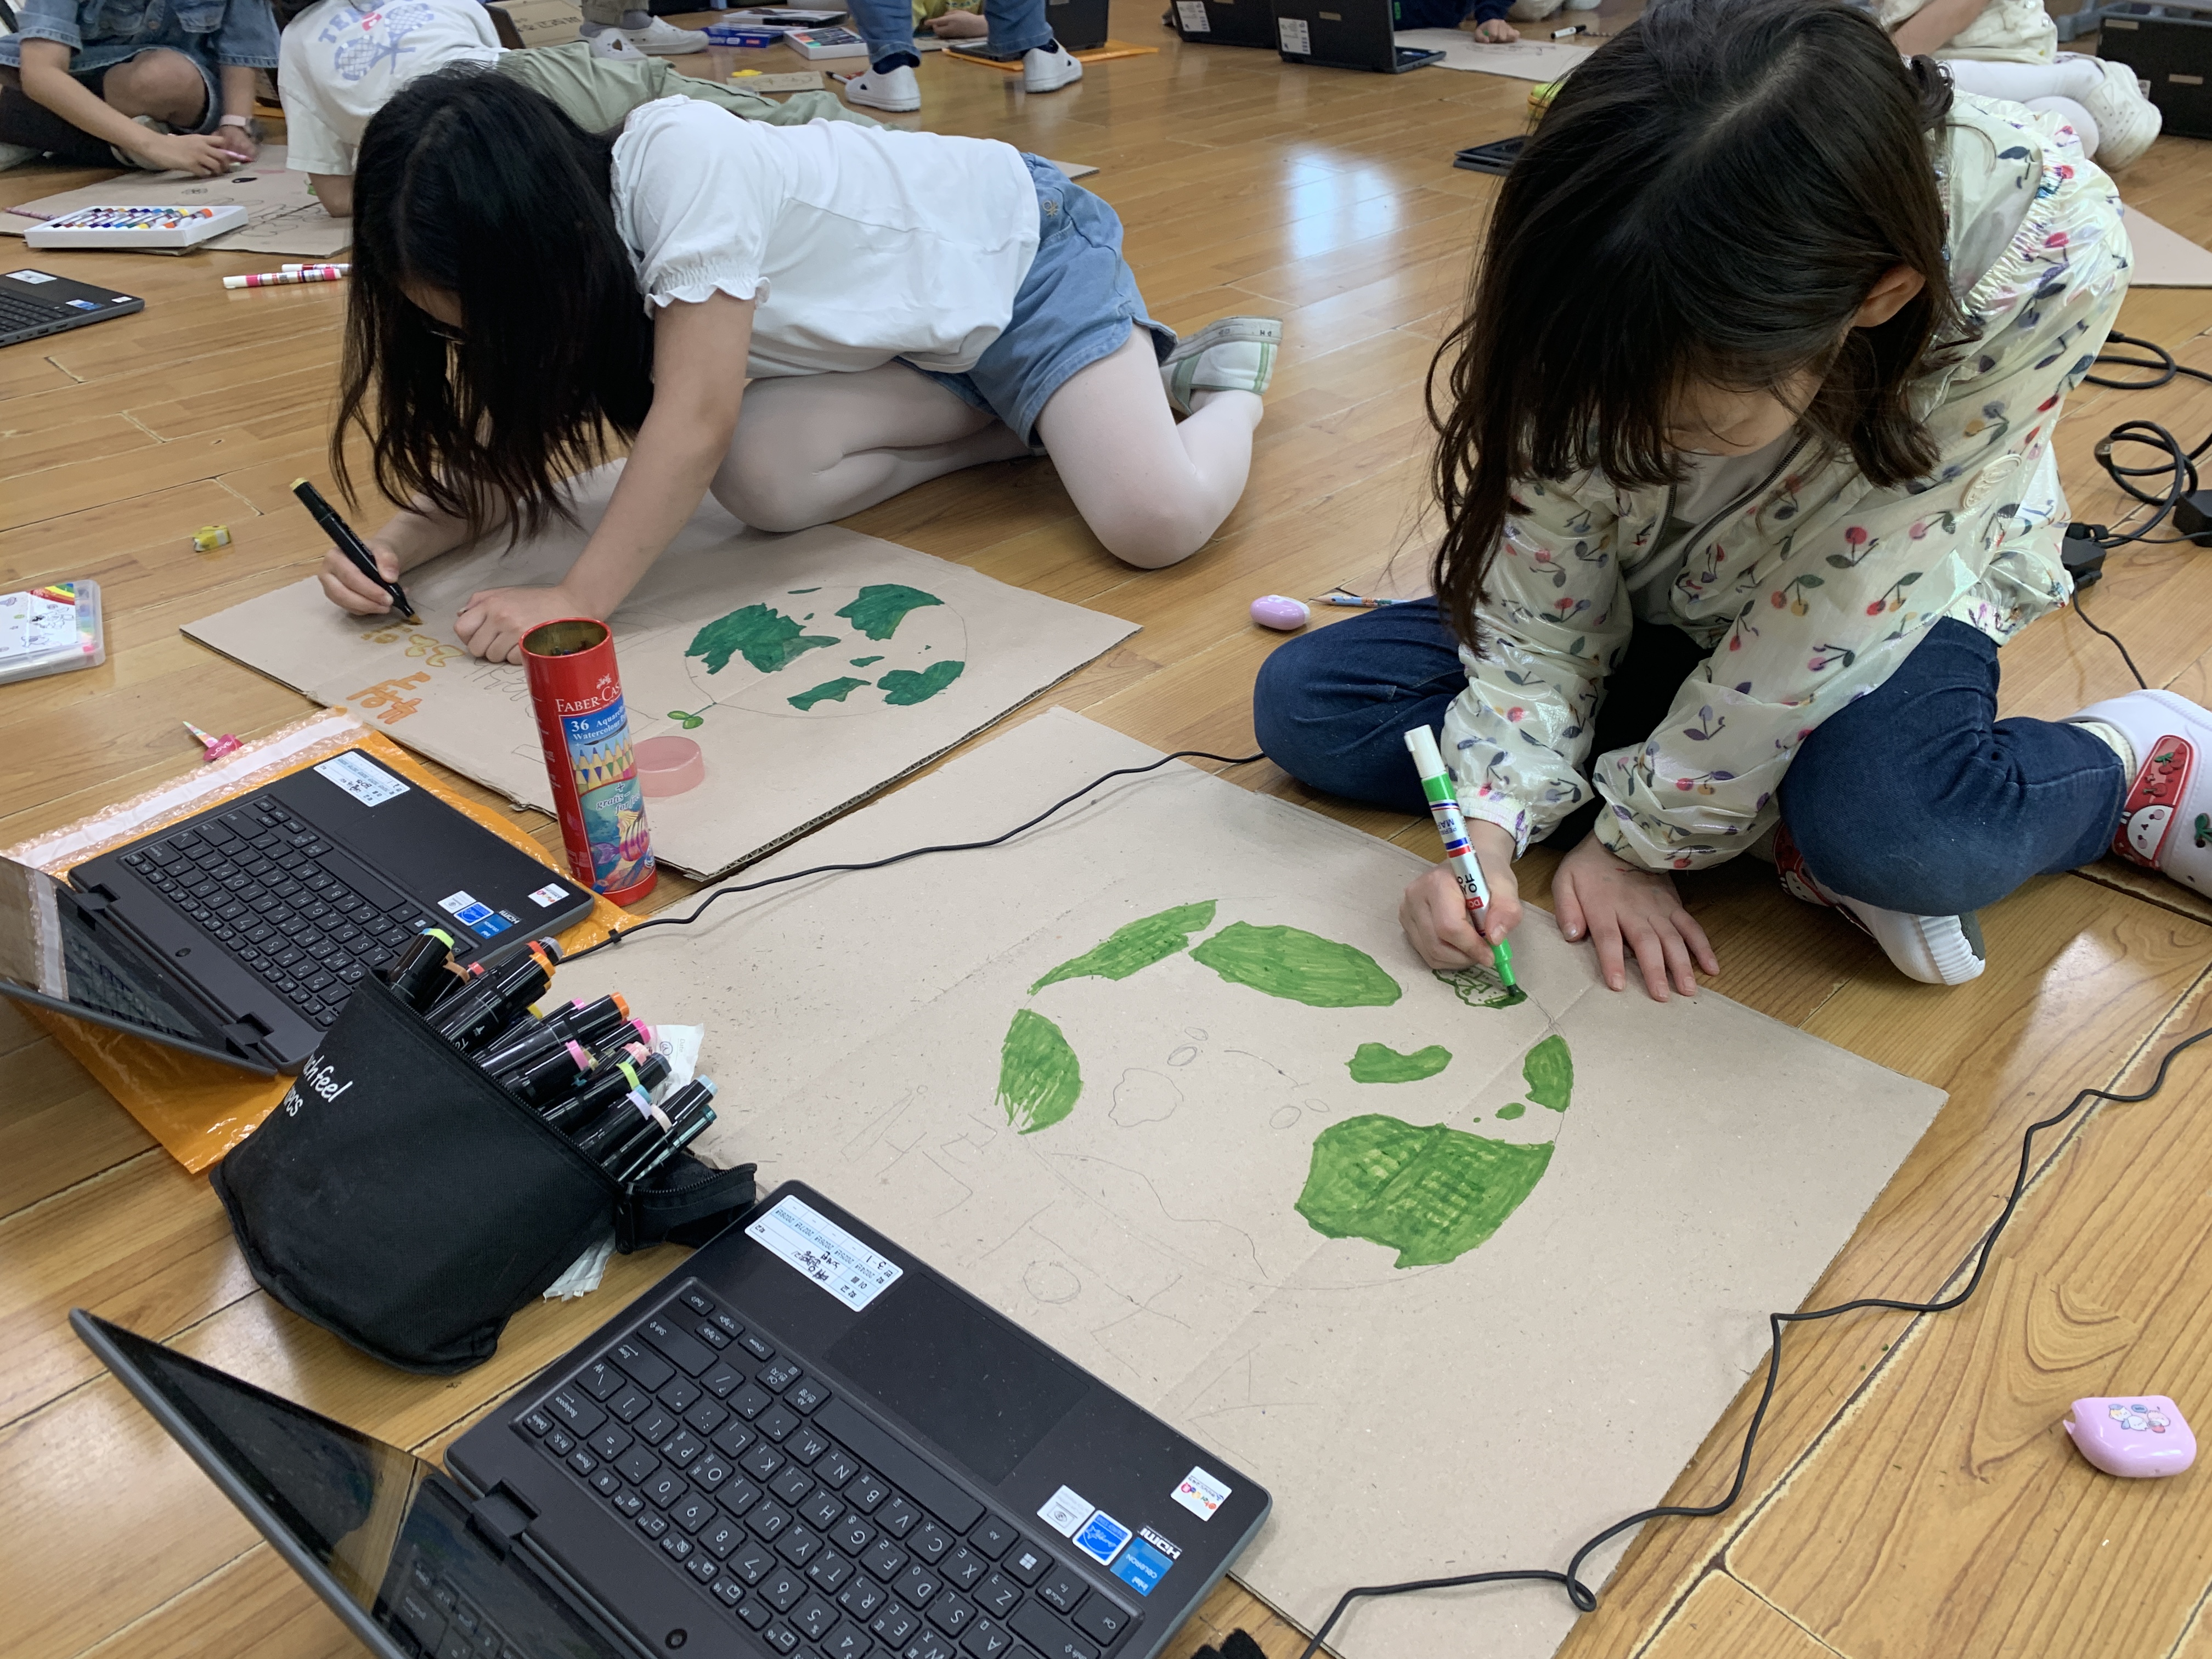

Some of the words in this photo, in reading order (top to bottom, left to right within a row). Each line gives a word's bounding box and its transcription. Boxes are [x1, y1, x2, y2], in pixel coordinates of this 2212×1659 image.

[571, 719, 589, 732] 36
[573, 720, 620, 741] Watercolour
[596, 793, 624, 810] gratis
[614, 802, 630, 816] for
[555, 1396, 578, 1418] Backspace
[736, 1435, 746, 1448] L
[804, 1439, 821, 1455] M
[681, 1447, 694, 1458] P
[760, 1457, 775, 1471] K
[708, 1468, 722, 1481] O
[833, 1464, 850, 1480] N
[658, 1481, 670, 1493] 0
[790, 1482, 804, 1492] J
[738, 1492, 749, 1503] I
[867, 1489, 879, 1503] B
[687, 1506, 698, 1517] 9
[820, 1505, 835, 1520] H
[765, 1516, 781, 1531] U
[895, 1514, 909, 1528] V
[716, 1530, 729, 1542] 8
[851, 1530, 865, 1544] G
[795, 1542, 809, 1556] Y
[928, 1538, 943, 1552] C
[1139, 1527, 1182, 1560] HDMI
[744, 1558, 759, 1570] 7
[883, 1558, 898, 1571] F
[1126, 1553, 1158, 1579] CELERON
[827, 1568, 841, 1582] T
[962, 1564, 977, 1579] X
[777, 1581, 789, 1594] 6
[917, 1583, 932, 1598] D
[861, 1593, 876, 1609] R
[996, 1590, 1012, 1606] Z
[807, 1609, 821, 1621] 5
[950, 1609, 964, 1624] S
[894, 1621, 909, 1637] E
[840, 1636, 854, 1647] 4
[987, 1635, 1002, 1651] A
